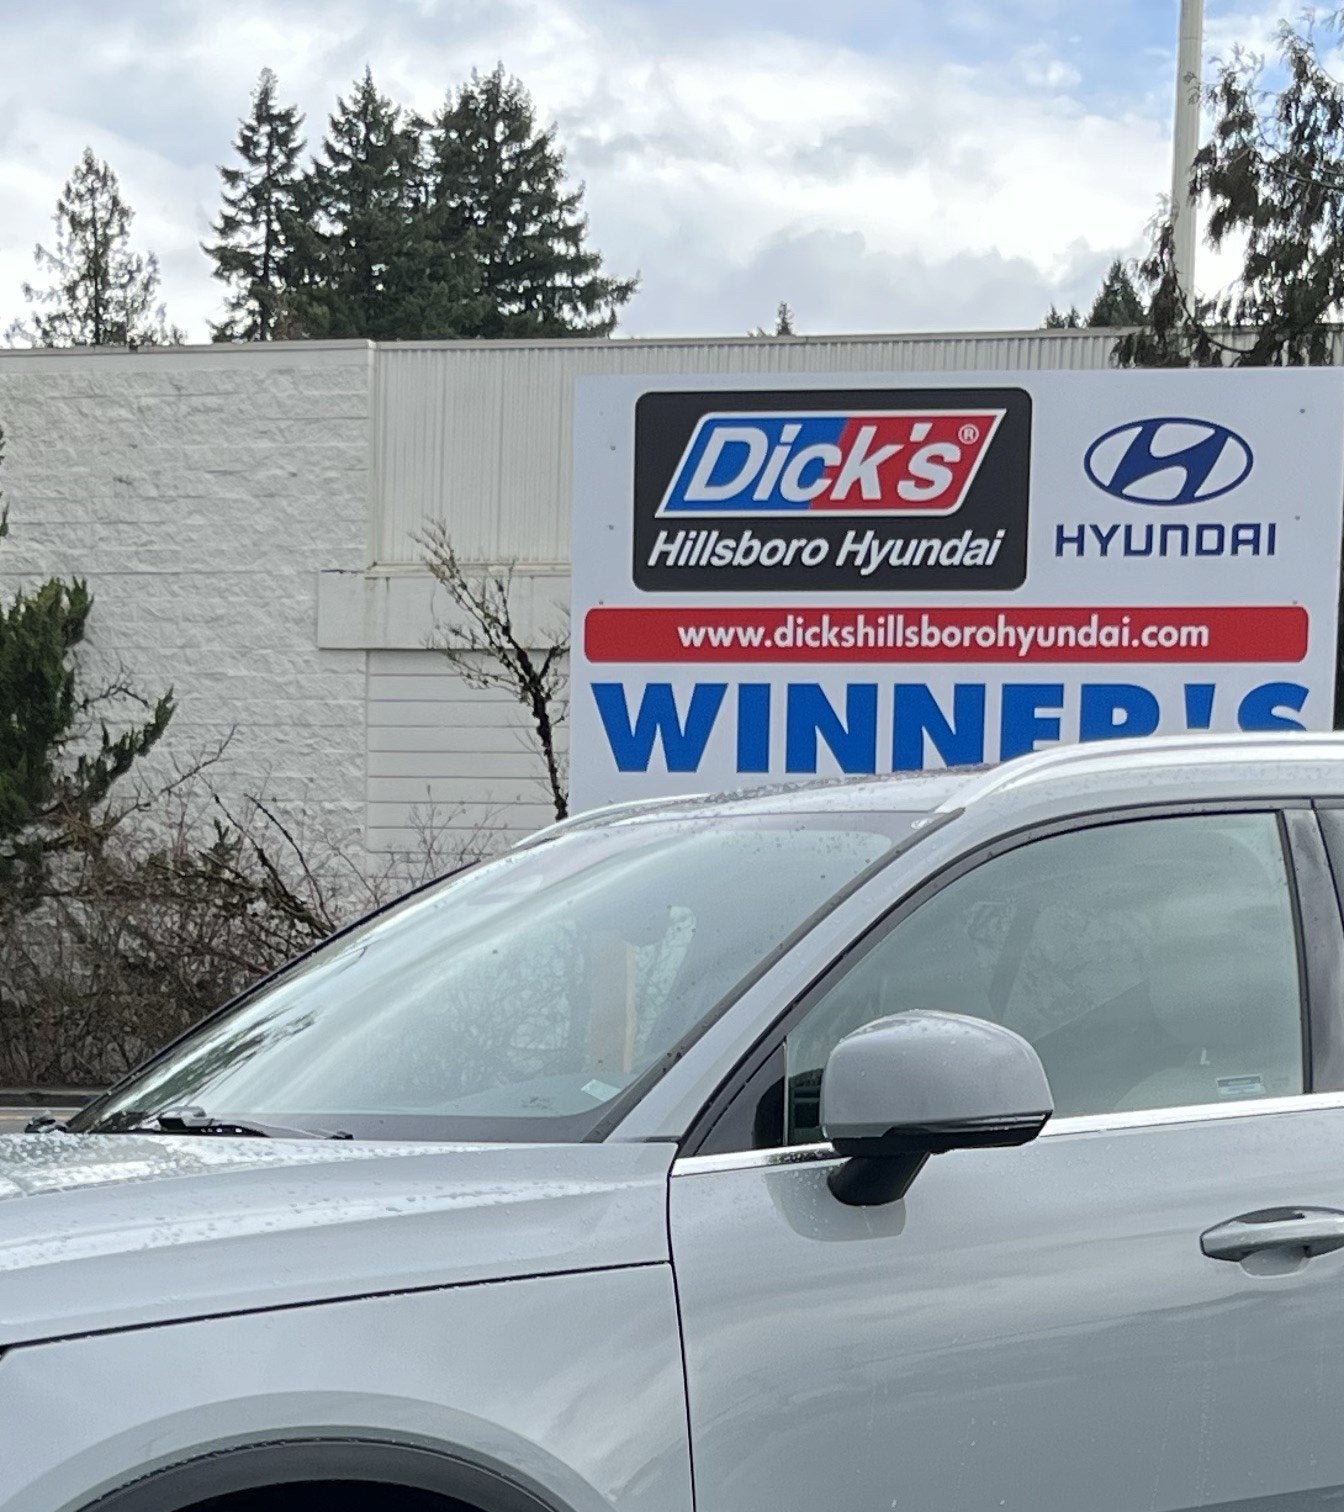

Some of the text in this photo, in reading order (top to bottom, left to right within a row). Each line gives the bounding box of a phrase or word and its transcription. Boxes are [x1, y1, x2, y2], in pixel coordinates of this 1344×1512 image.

[684, 424, 960, 501] Dick's
[649, 530, 1005, 575] Hillsboro Hyundai
[1056, 523, 1276, 556] HYUNDAI
[678, 613, 1209, 656] www.dickshillsborohyundai.com
